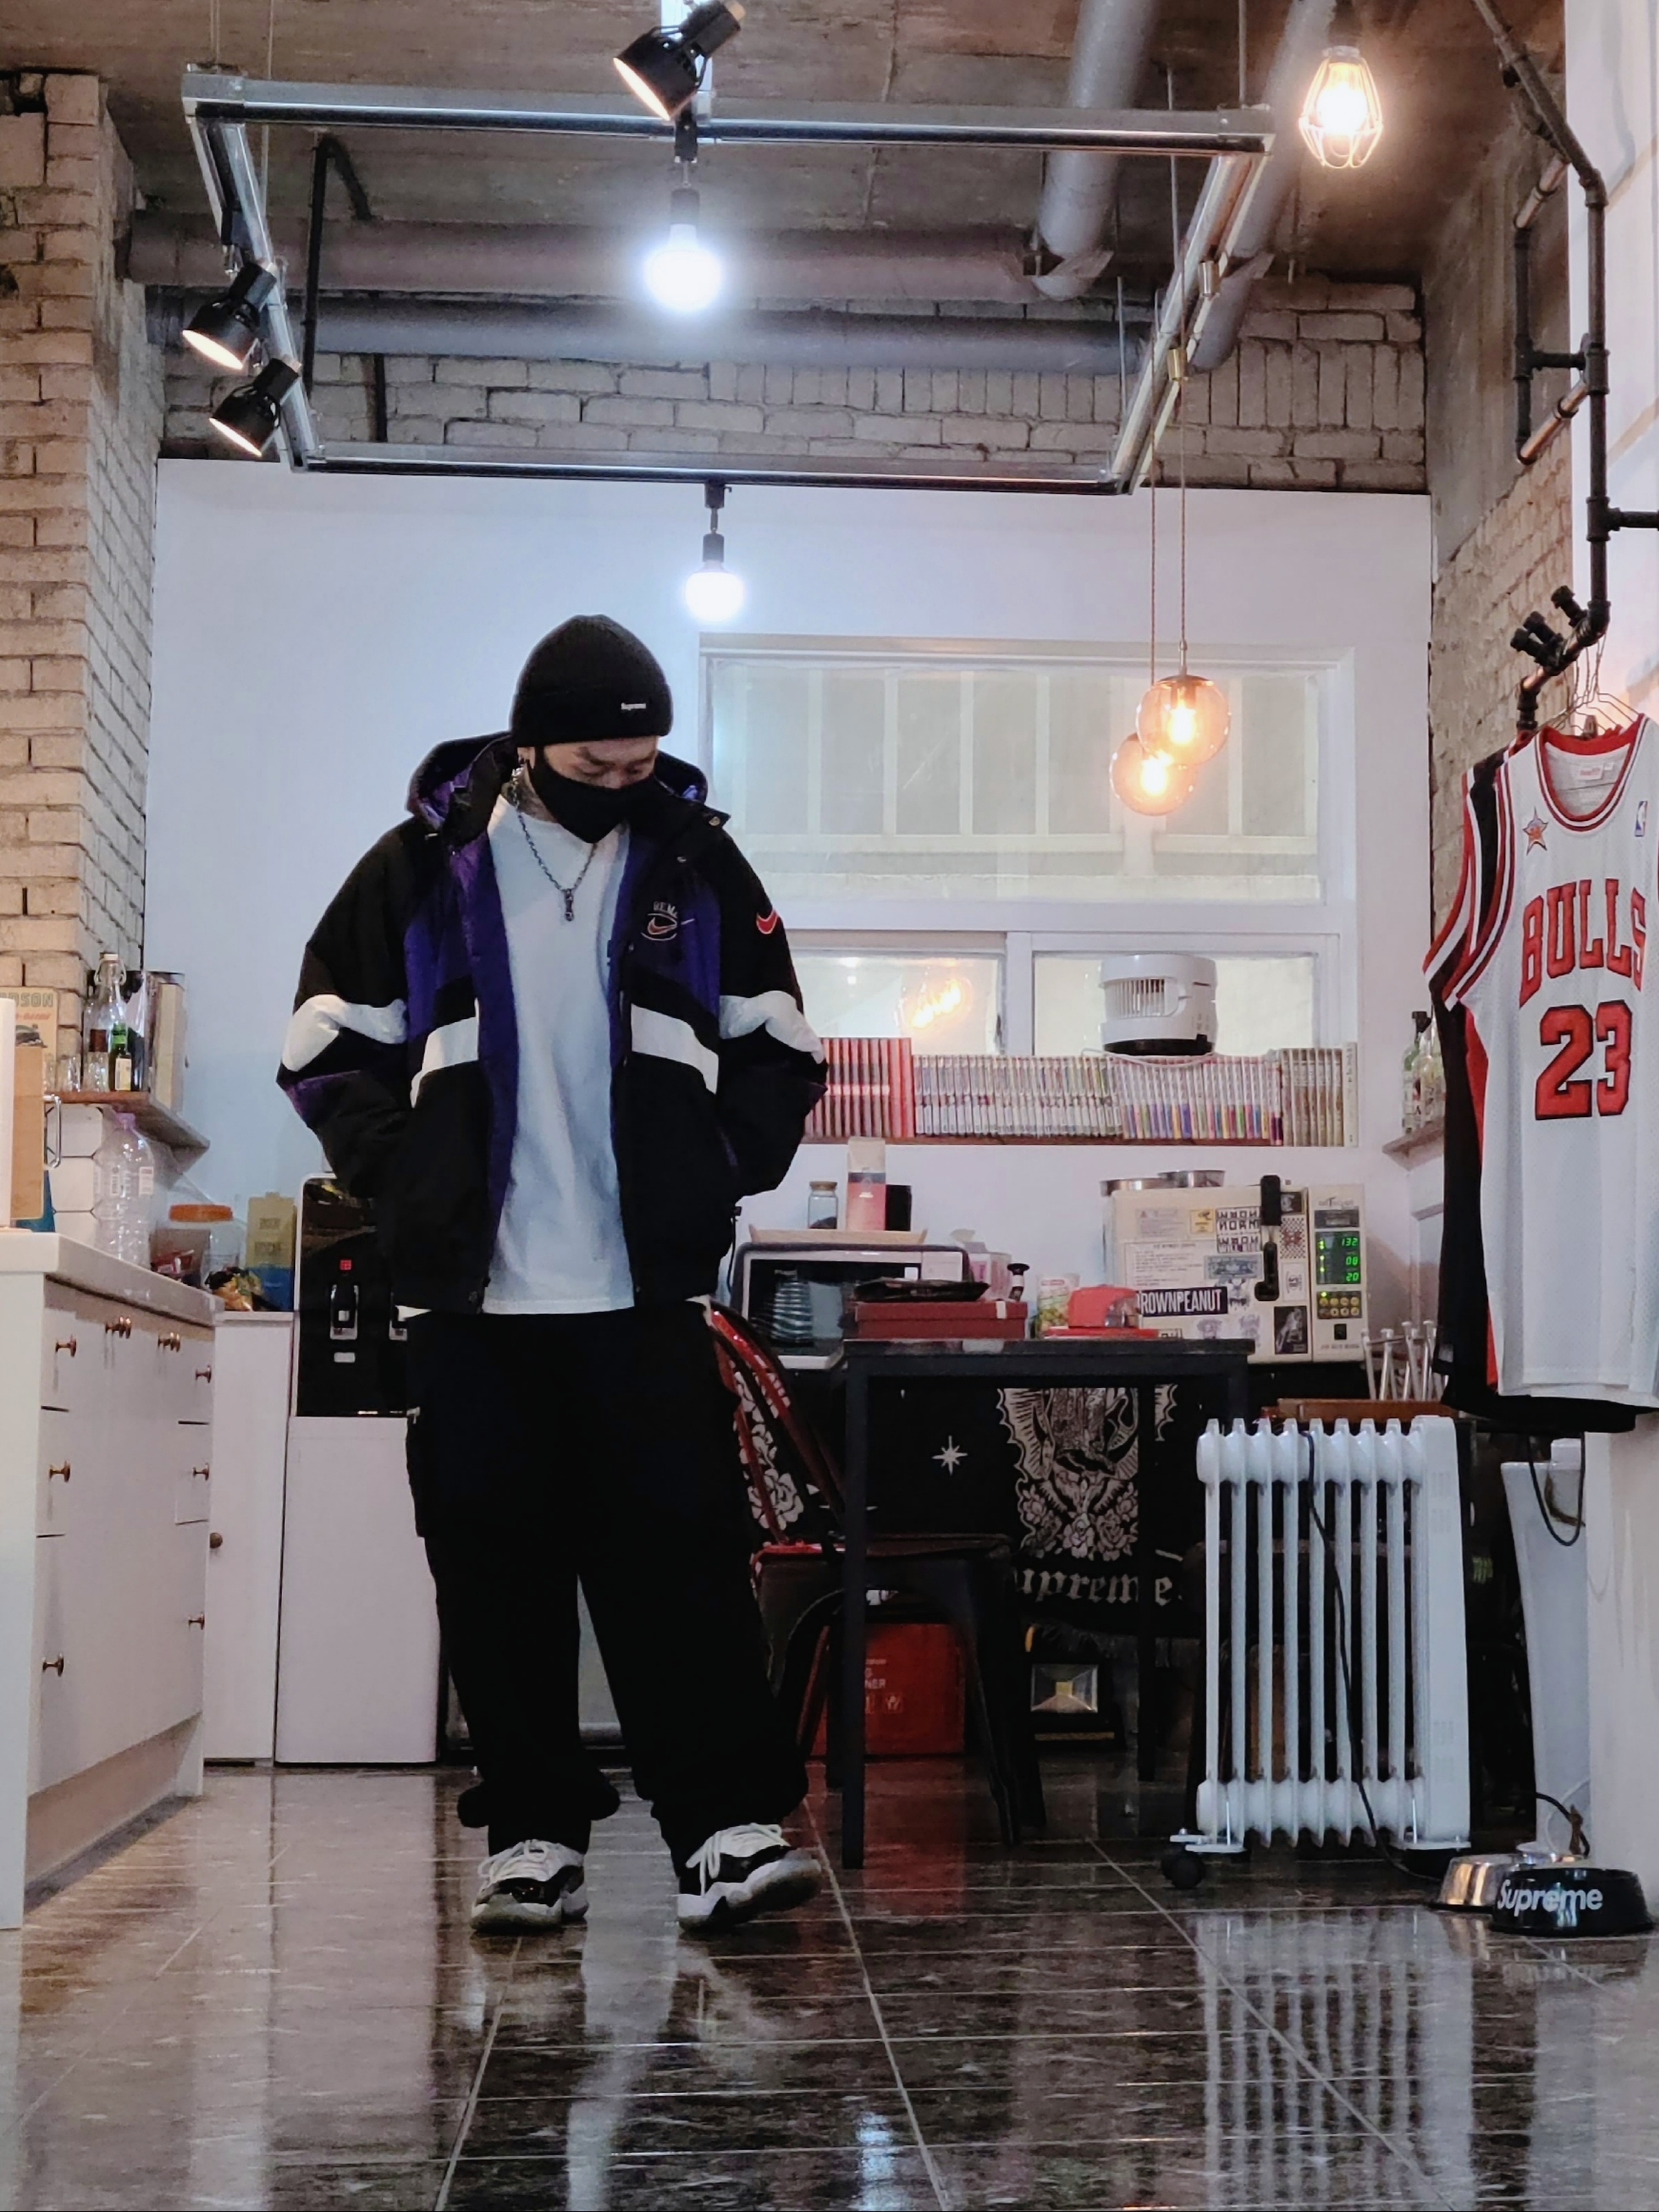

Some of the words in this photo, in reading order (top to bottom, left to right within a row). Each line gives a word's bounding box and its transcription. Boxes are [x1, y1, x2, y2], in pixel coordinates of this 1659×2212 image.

[1520, 878, 1646, 1008] BULLS
[1535, 999, 1633, 1121] 23
[1341, 1238, 1358, 1247] 132
[1345, 1272, 1359, 1282] 20
[1497, 1878, 1603, 1917] Supreme
